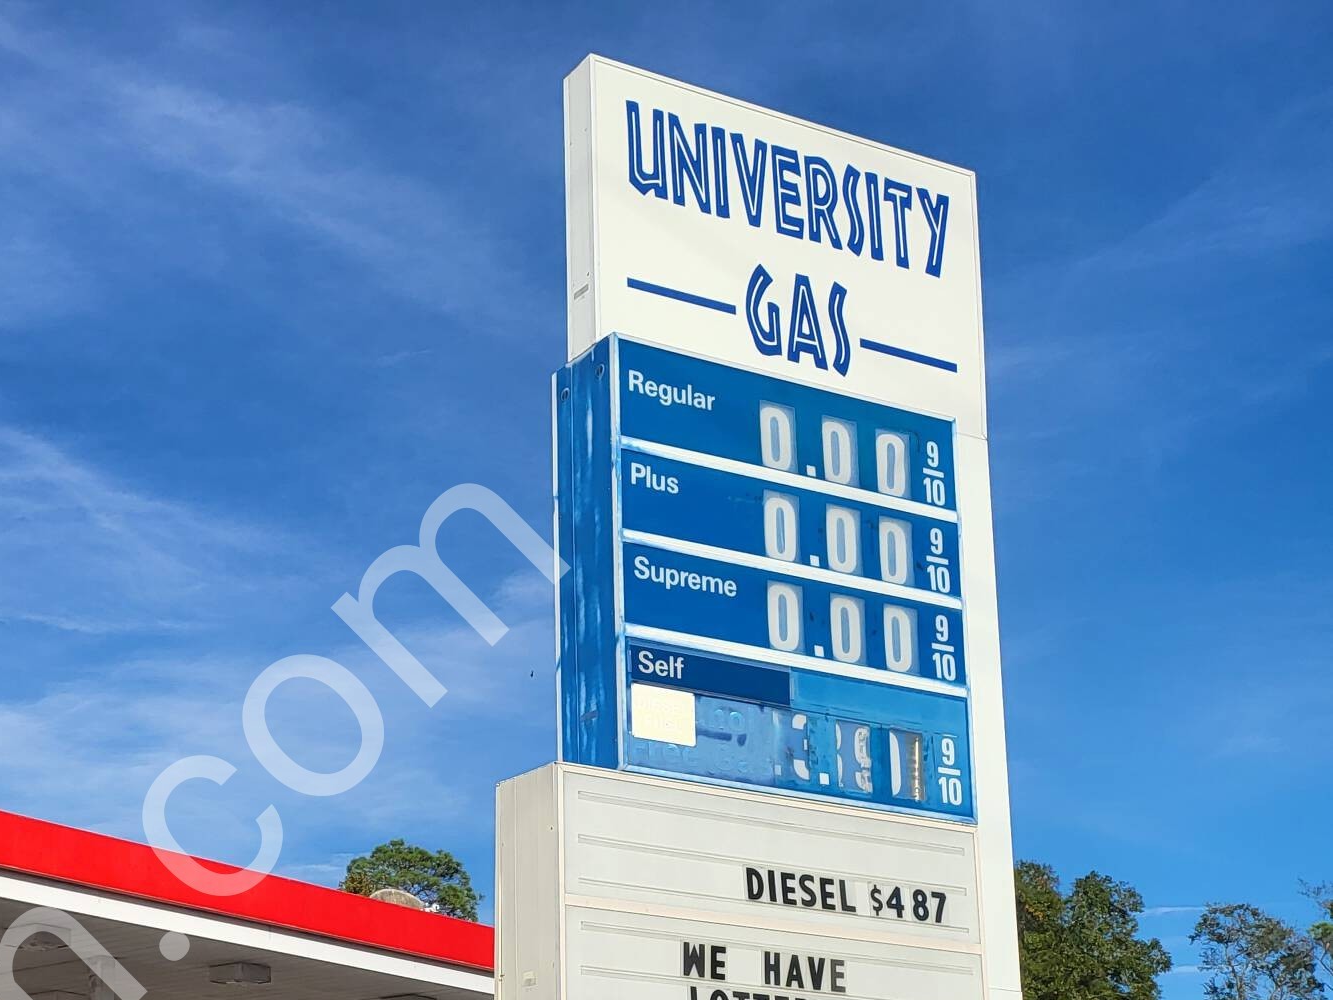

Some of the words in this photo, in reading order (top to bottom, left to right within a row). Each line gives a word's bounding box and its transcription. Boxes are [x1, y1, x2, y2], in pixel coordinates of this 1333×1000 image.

[626, 100, 950, 279] UNIVERSITY
[745, 263, 851, 377] GAS
[628, 369, 715, 412] Regular
[630, 462, 679, 495] Plus
[633, 556, 737, 598] Supreme
[637, 650, 684, 680] Self
[745, 867, 856, 913] DIESEL
[683, 941, 726, 980] WE
[764, 950, 846, 993] HAVE
